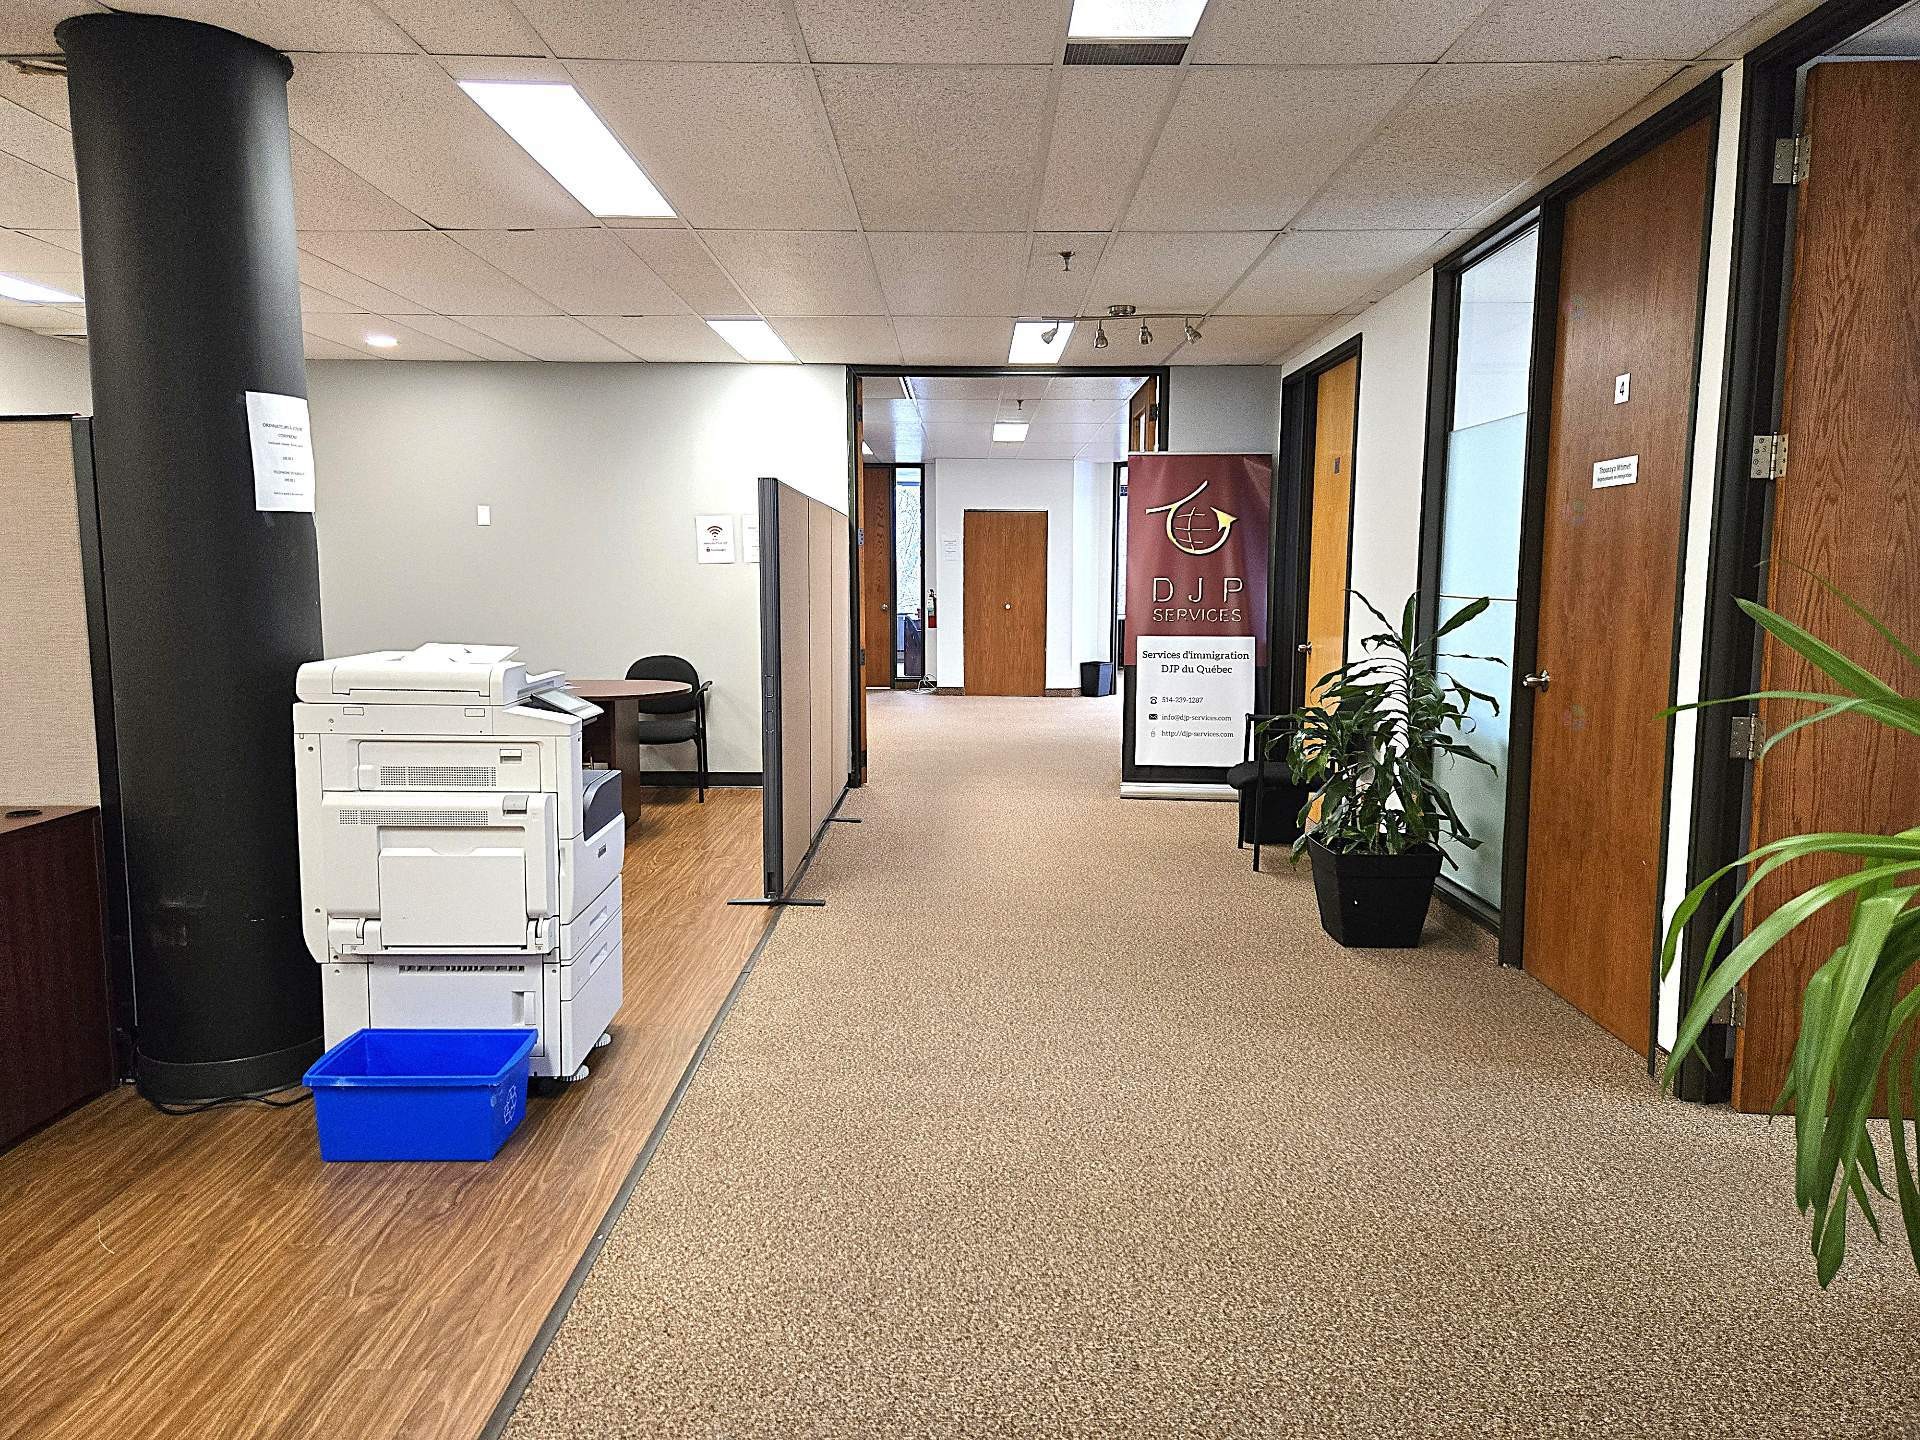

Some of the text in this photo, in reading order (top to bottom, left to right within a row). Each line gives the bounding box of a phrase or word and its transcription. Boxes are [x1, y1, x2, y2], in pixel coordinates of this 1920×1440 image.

[1619, 381, 1625, 396] 4
[1152, 608, 1242, 622] SERVICES
[1142, 650, 1250, 662] Services d'immigration
[1161, 664, 1233, 675] DJP du Québec
